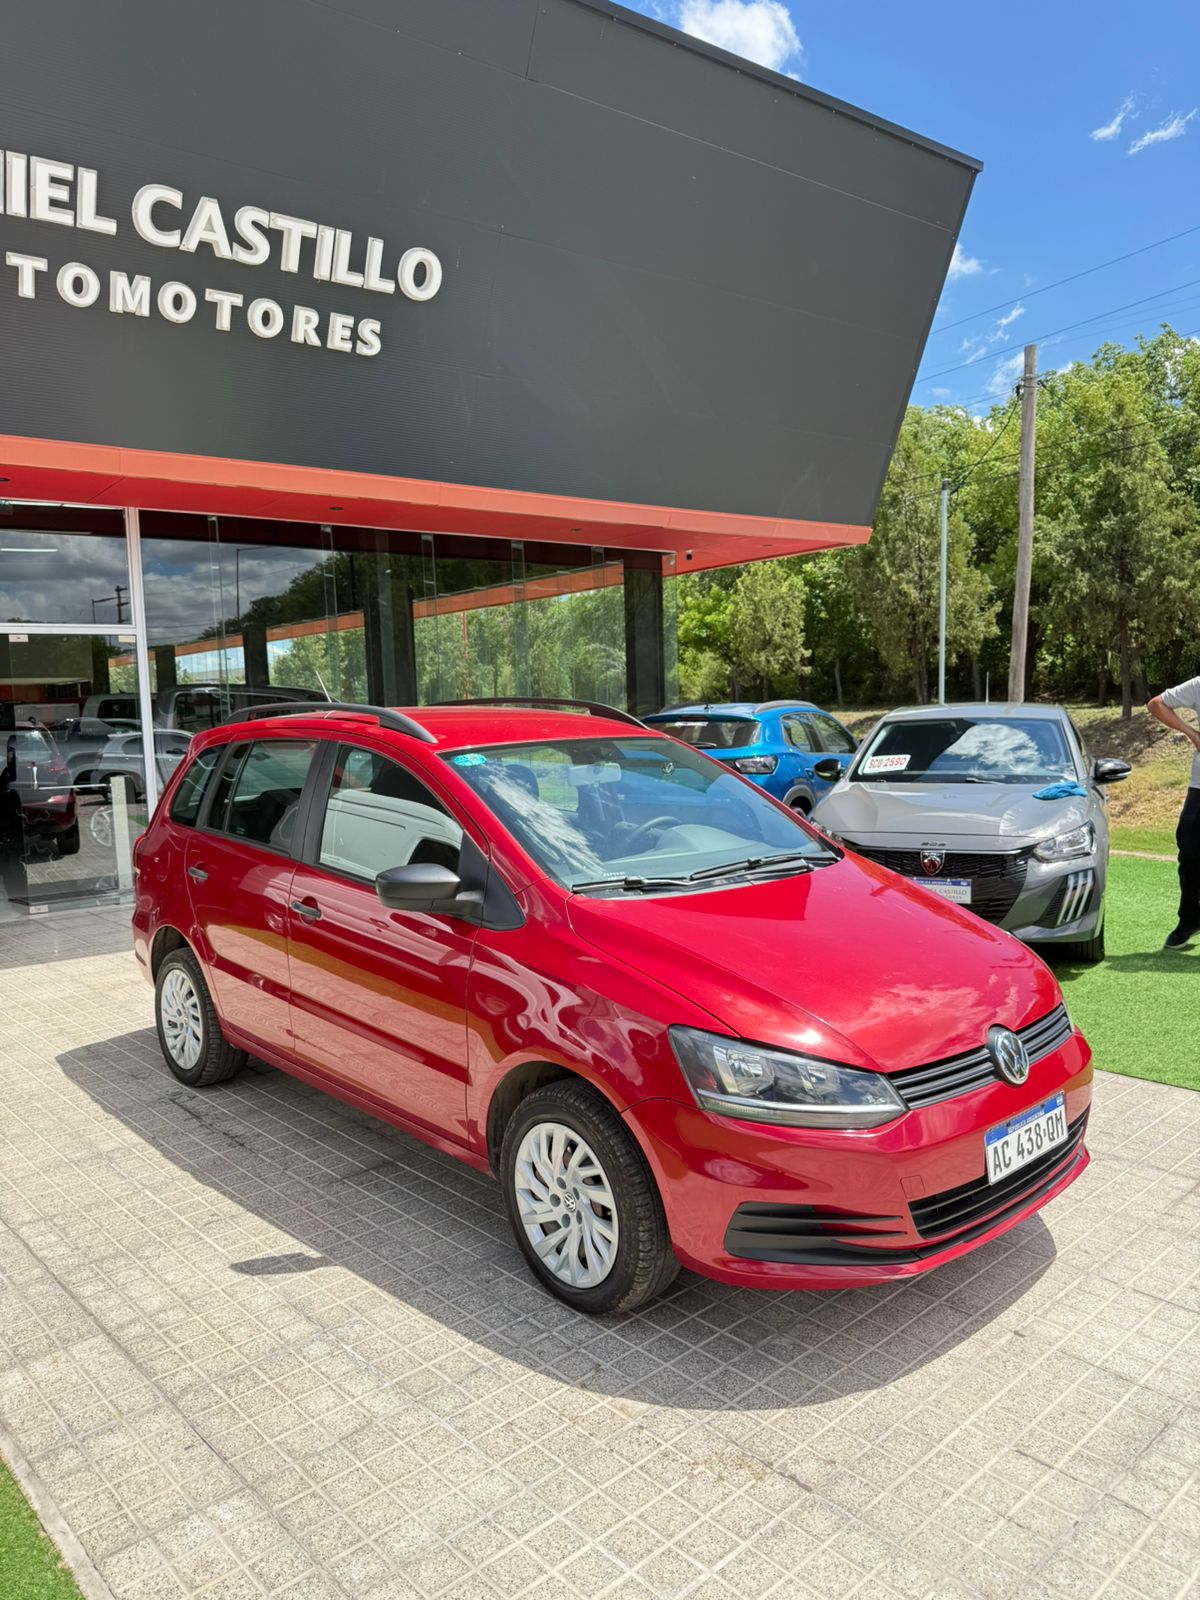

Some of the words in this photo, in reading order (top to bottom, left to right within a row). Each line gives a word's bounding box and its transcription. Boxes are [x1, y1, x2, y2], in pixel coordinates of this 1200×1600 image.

[0, 149, 117, 236] IEL
[131, 183, 443, 302] CASTILLO
[5, 251, 382, 357] TOMOTORES
[993, 1139, 1012, 1176] AC
[1016, 1122, 1044, 1160] 438
[1046, 1110, 1065, 1142] QM
